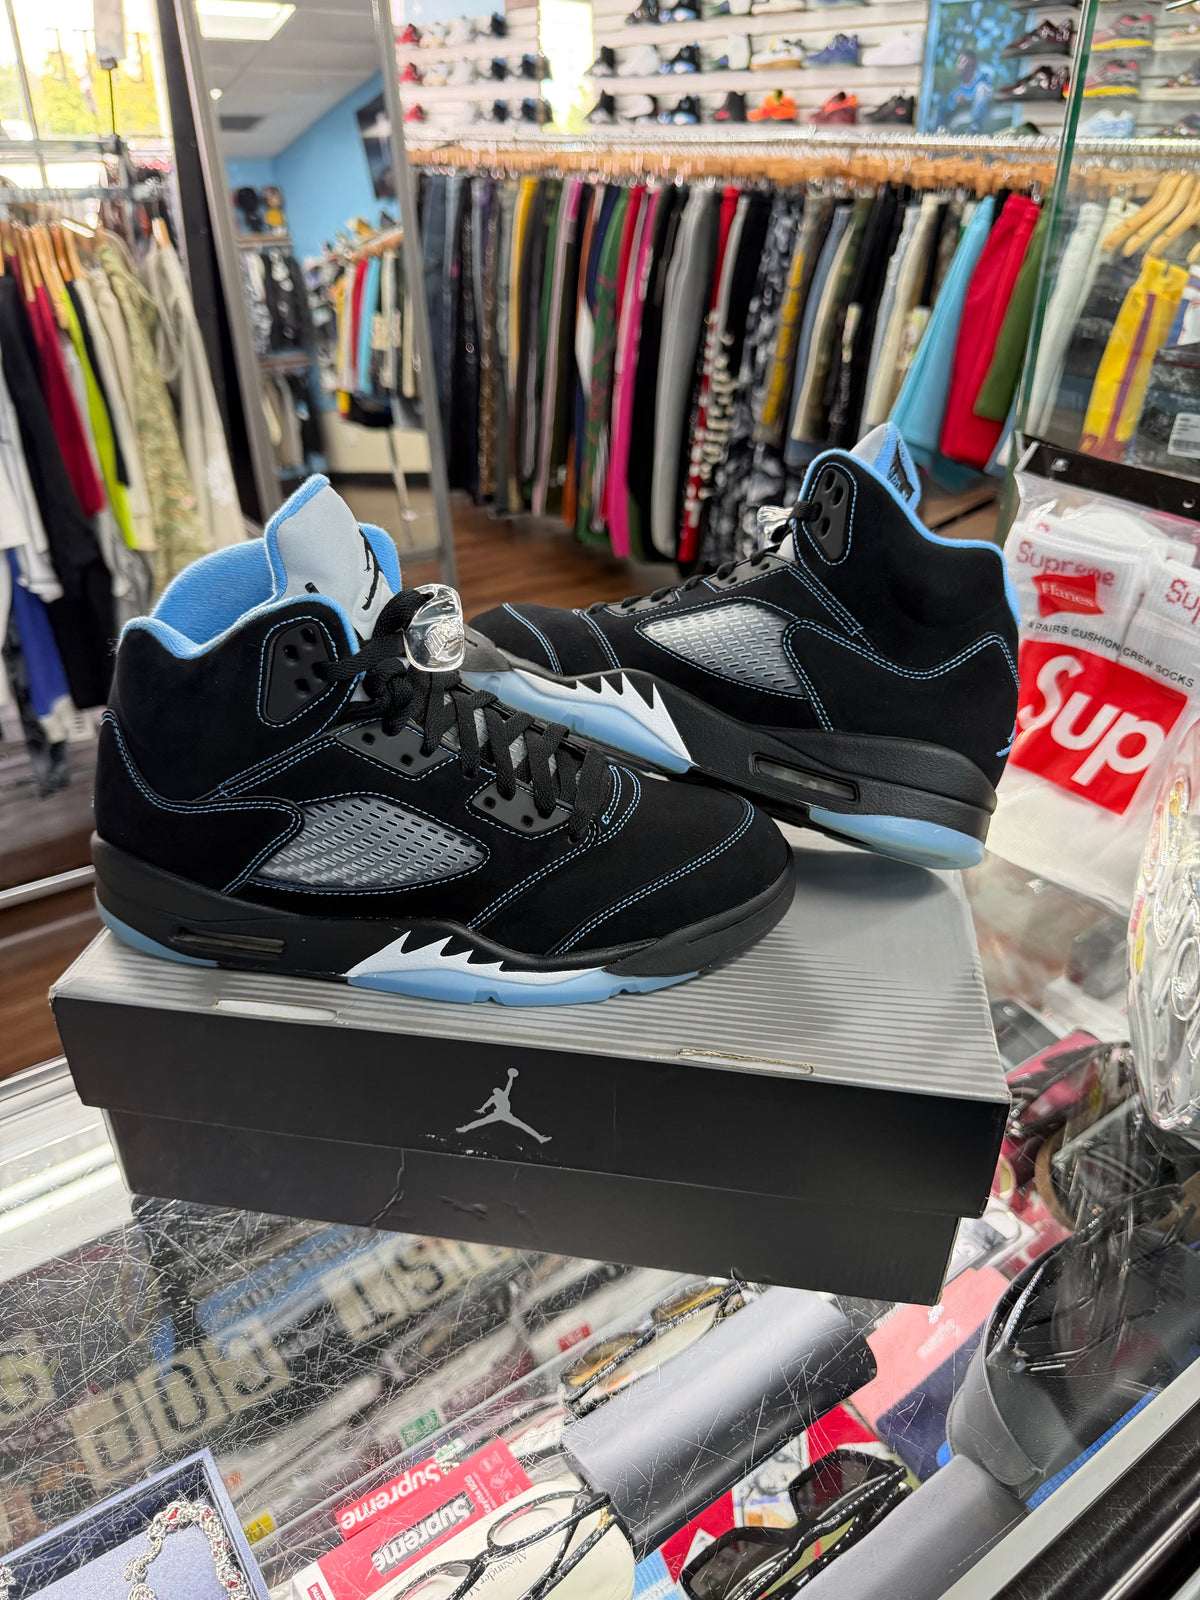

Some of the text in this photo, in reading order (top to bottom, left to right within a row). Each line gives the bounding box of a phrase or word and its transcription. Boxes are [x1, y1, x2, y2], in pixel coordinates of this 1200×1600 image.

[1041, 582, 1096, 608] Hanes
[1035, 621, 1068, 635] PAIRS
[1071, 628, 1121, 652] CUSHION
[1122, 647, 1153, 668] CREW
[1155, 664, 1195, 688] SOCKS
[1017, 654, 1165, 787] Sup
[341, 1464, 441, 1530] Supreme
[372, 1498, 472, 1570] Supreme
[480, 1550, 527, 1585] Alexander
